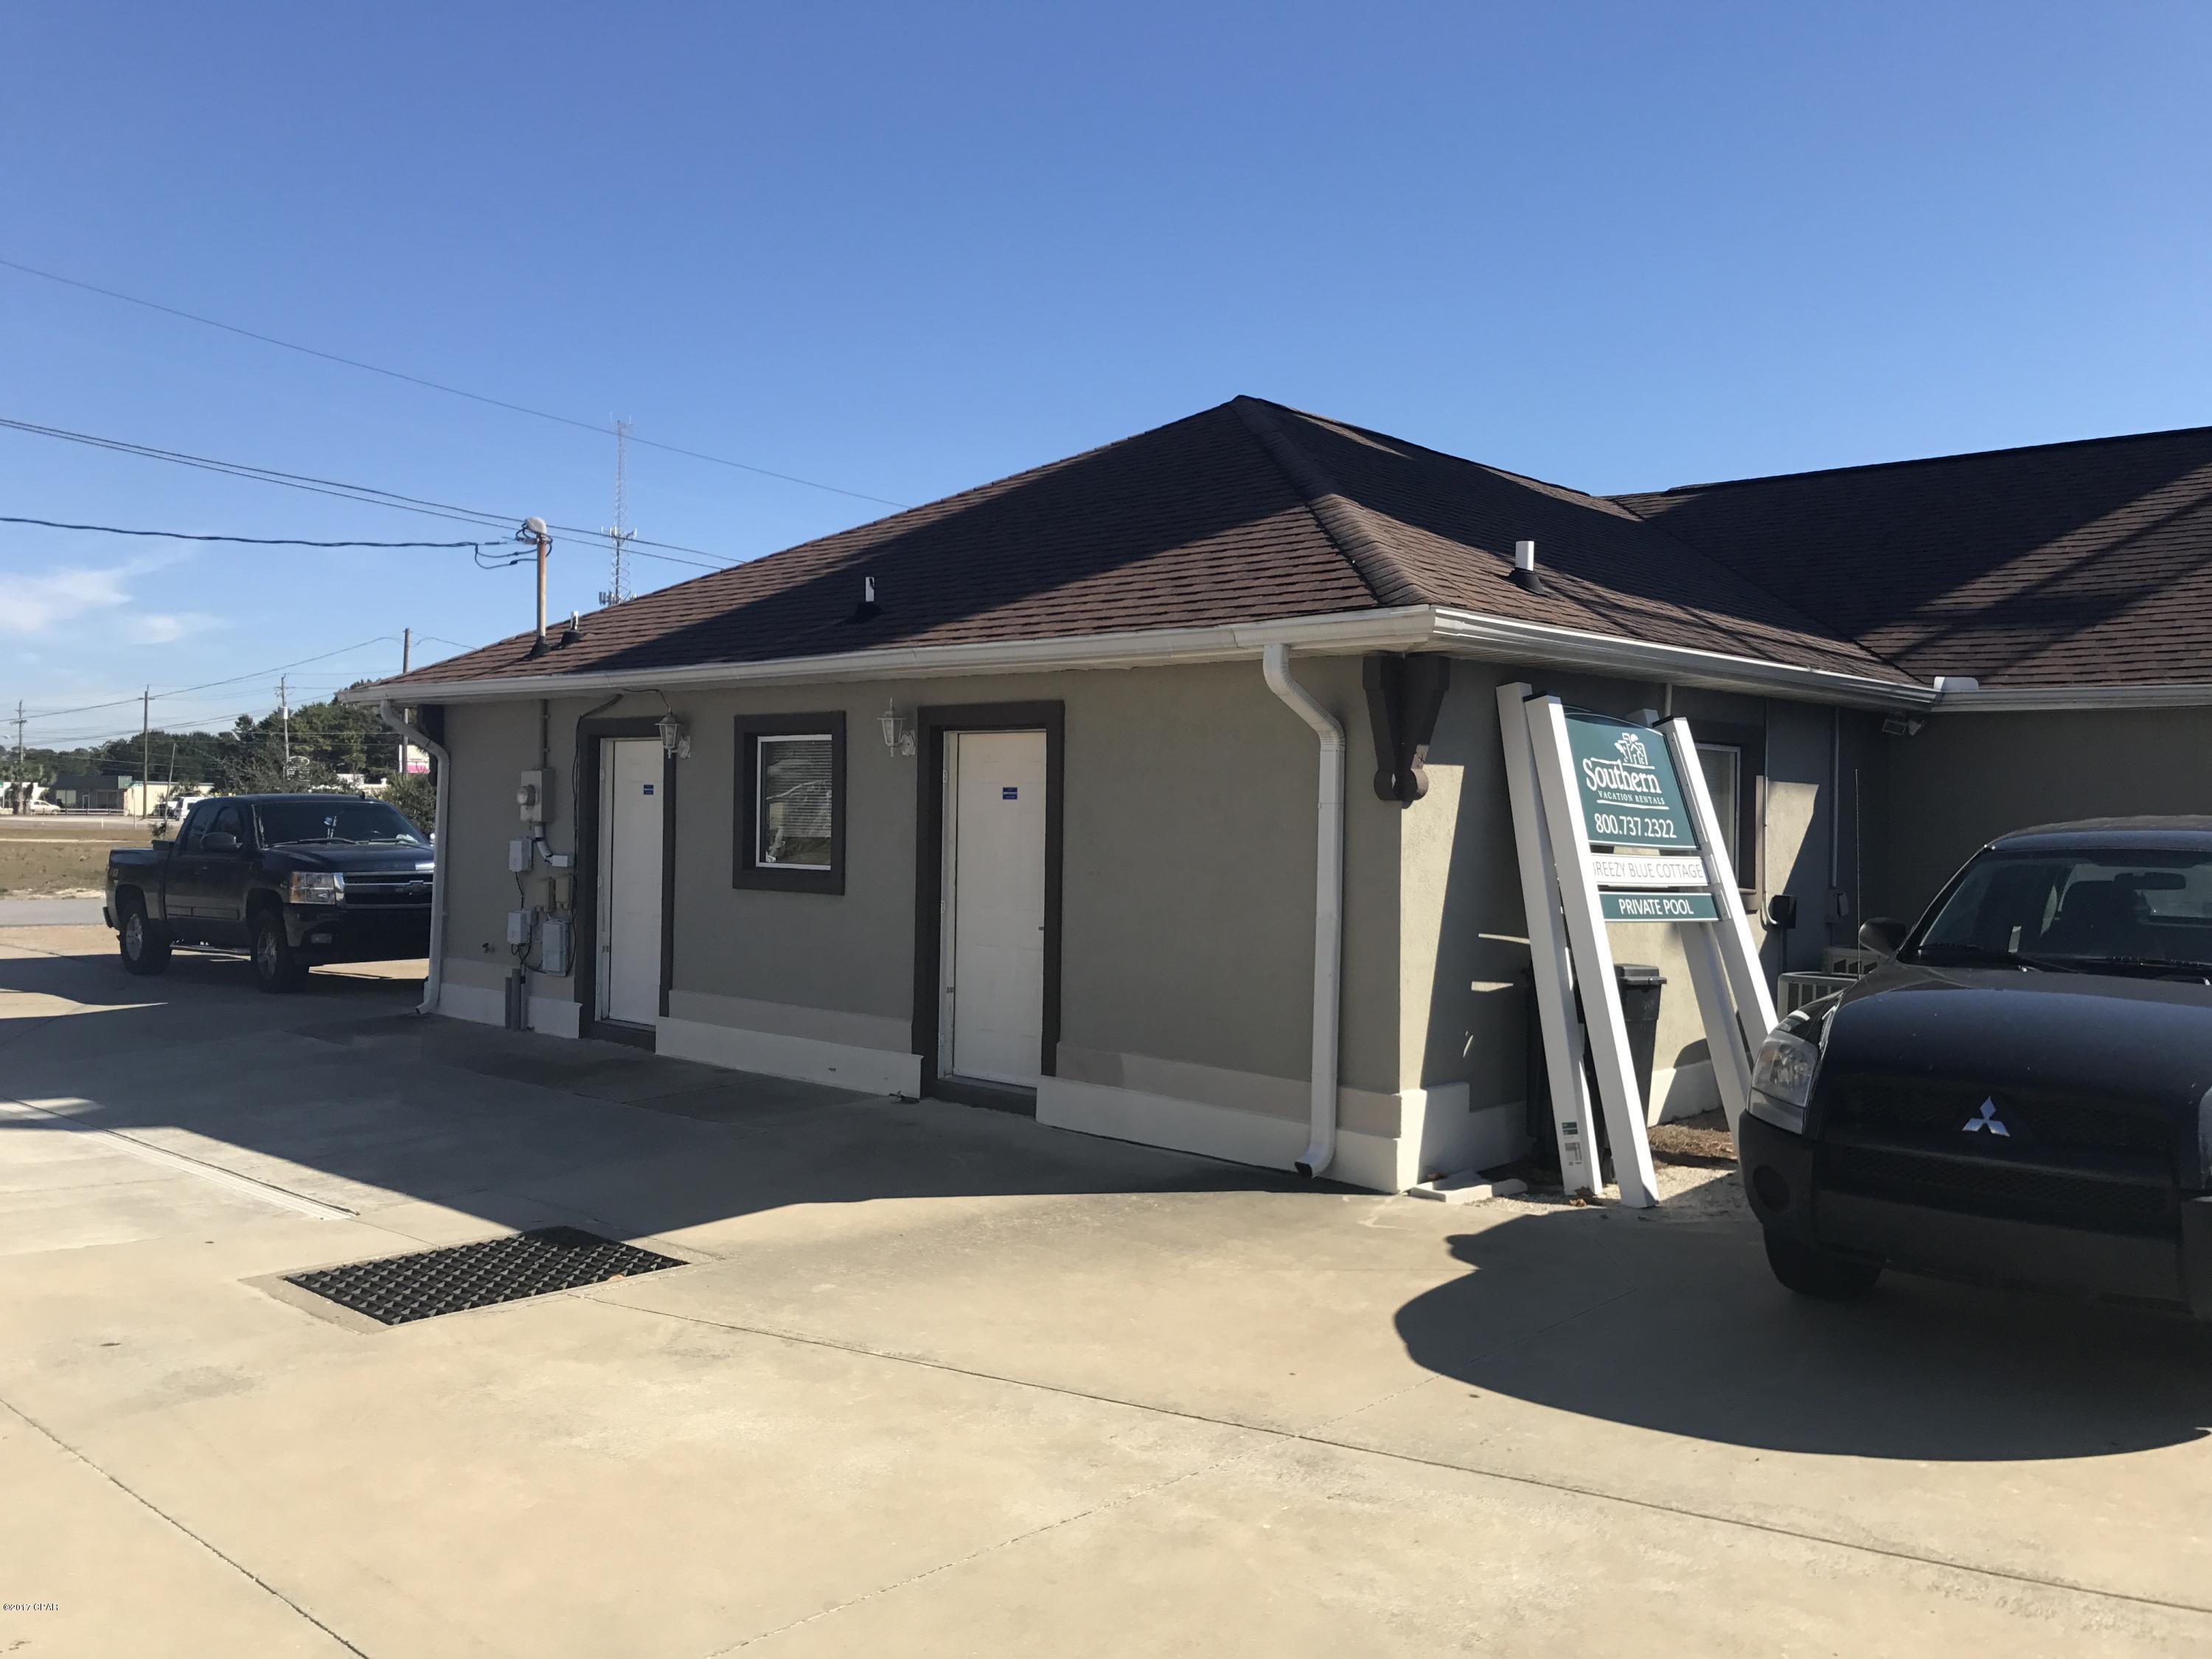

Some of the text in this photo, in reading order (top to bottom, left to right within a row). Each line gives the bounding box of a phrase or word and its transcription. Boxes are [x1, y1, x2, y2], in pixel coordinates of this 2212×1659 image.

[1582, 757, 1662, 793] Southern
[1598, 790, 1666, 805] VACATION RENTALS
[1594, 813, 1677, 838] 800.737.2322
[1628, 863, 1655, 878] BLUE
[1656, 863, 1704, 878] COTTAGE
[1618, 898, 1694, 915] PRIVATE POOL
